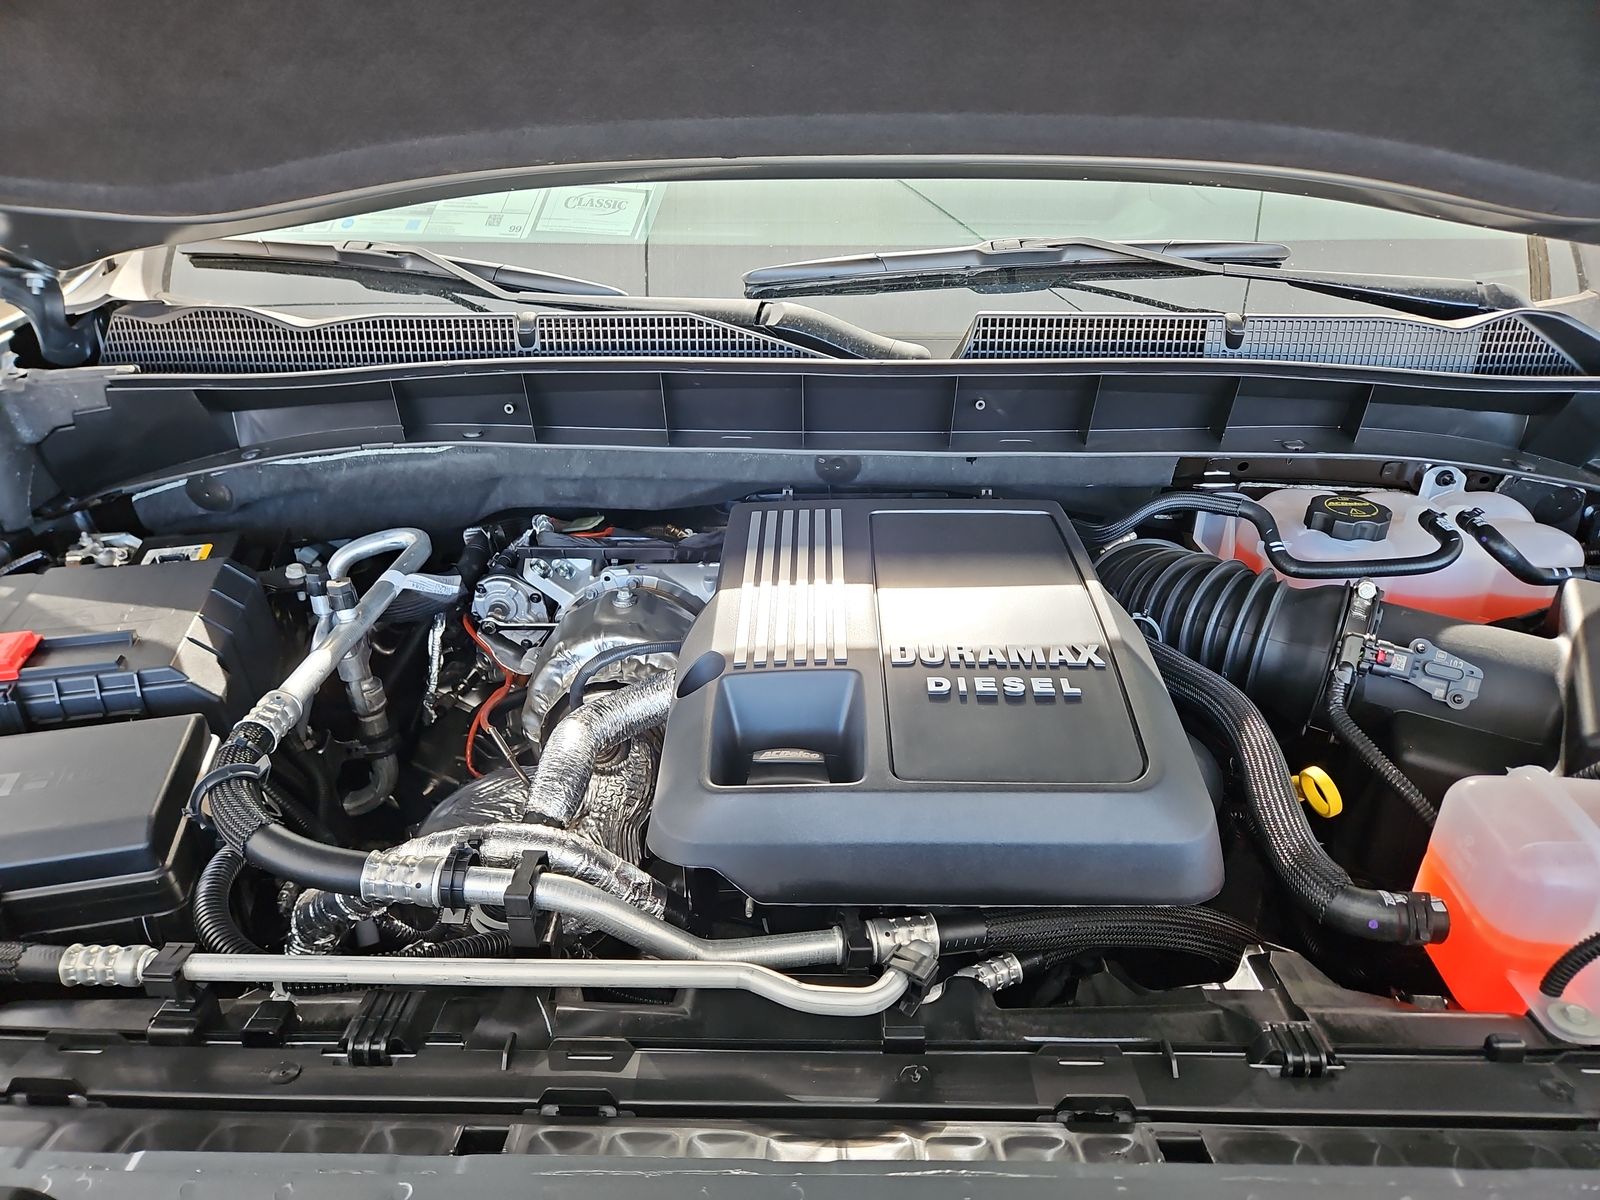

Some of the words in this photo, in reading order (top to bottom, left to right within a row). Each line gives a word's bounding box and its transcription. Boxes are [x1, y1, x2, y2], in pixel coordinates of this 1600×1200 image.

[565, 196, 628, 211] CLASSIC
[890, 643, 1106, 671] DURAMAX
[926, 676, 1082, 696] DIESEL
[759, 750, 820, 759] ACDelco
